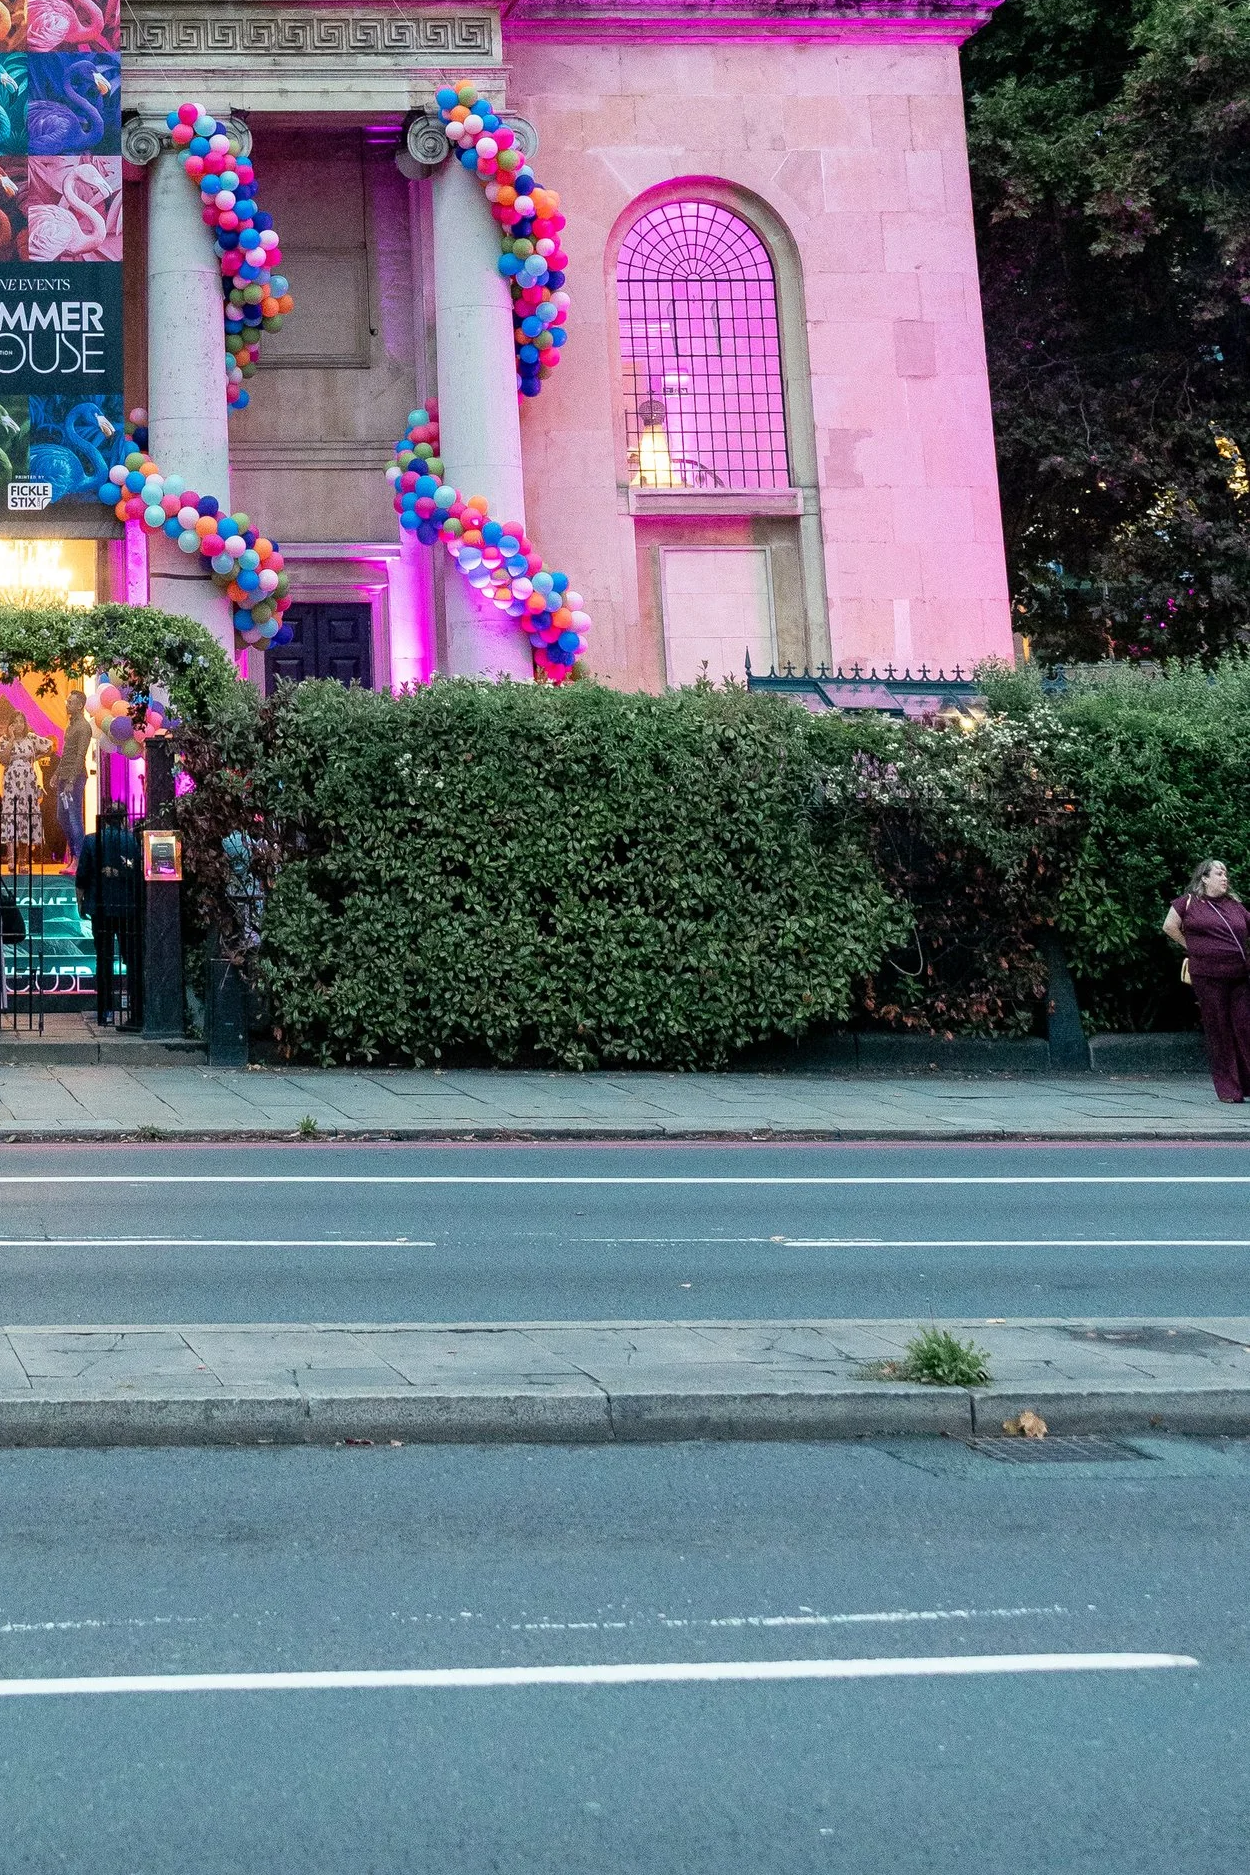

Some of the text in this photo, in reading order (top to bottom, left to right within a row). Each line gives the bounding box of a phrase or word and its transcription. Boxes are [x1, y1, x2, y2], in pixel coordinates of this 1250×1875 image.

[19, 278, 71, 291] EVENTS
[10, 485, 49, 496] FICKLE
[10, 497, 36, 508] STIX
